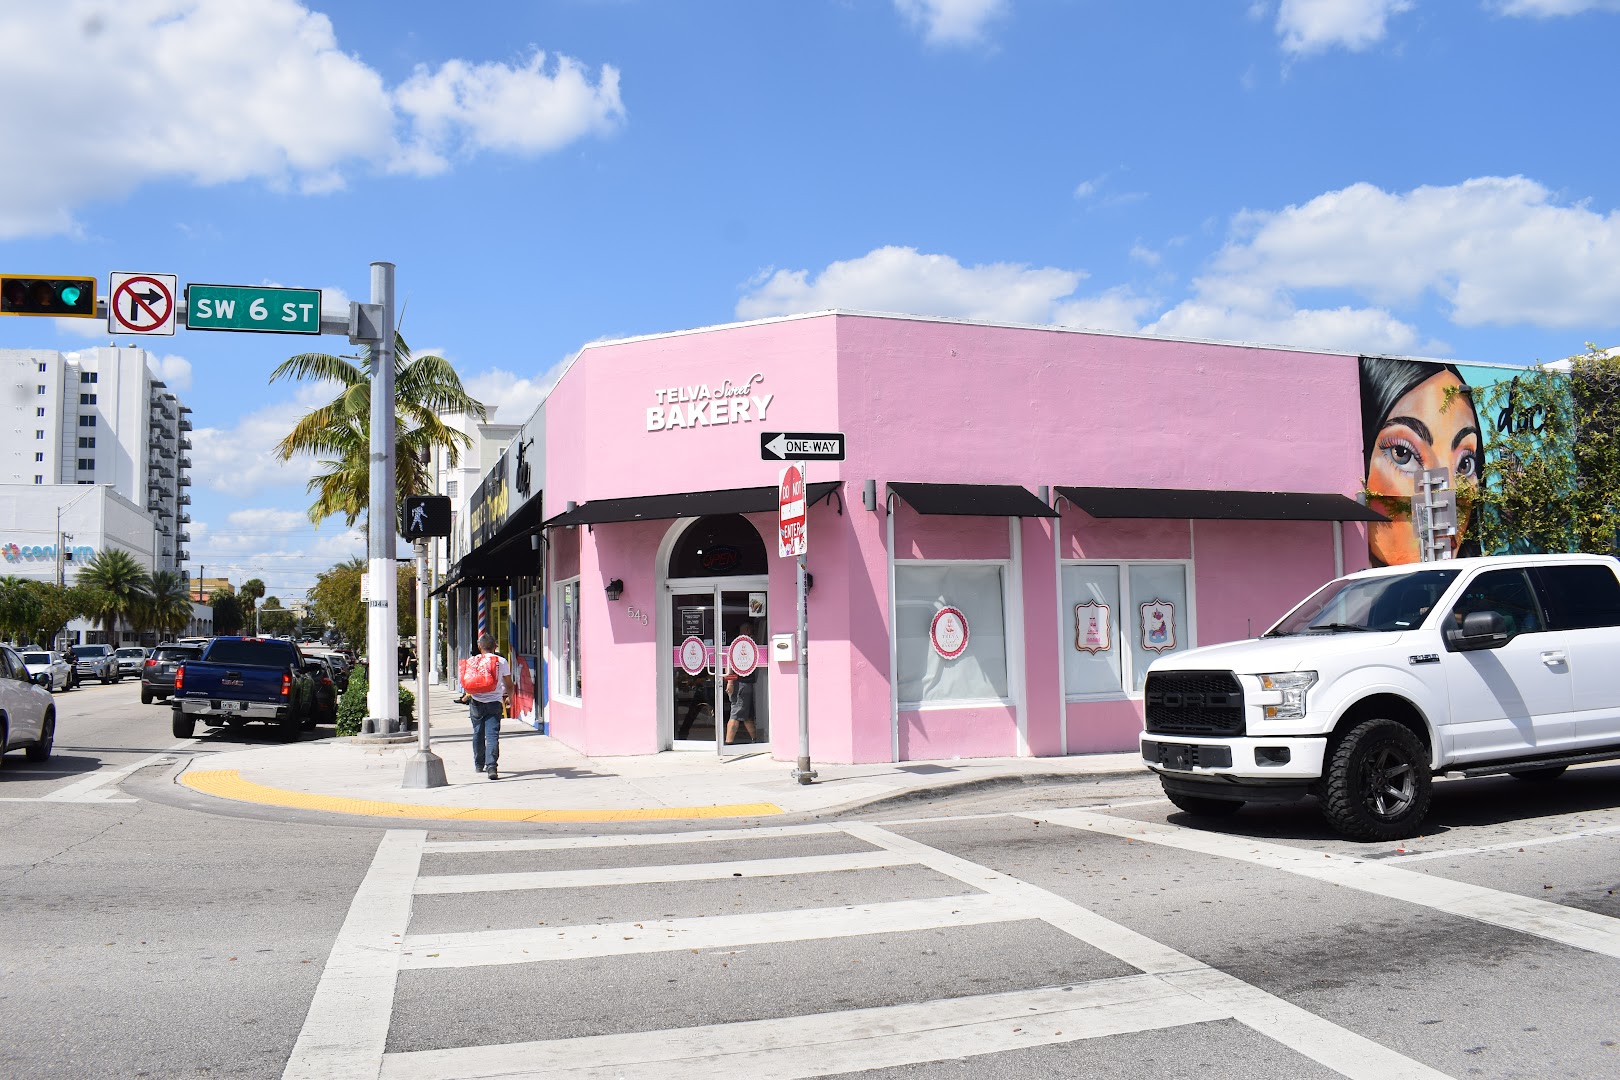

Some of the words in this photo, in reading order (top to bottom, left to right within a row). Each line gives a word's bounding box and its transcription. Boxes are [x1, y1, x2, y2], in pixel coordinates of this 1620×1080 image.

[196, 298, 236, 319] SW
[249, 297, 268, 321] 6
[281, 303, 315, 323] ST
[655, 384, 713, 405] TELVA
[713, 372, 765, 398] Sweet
[646, 394, 774, 432] BAKERY
[786, 441, 809, 453] ONE
[812, 441, 836, 453] WAY
[782, 485, 790, 500] DO
[792, 480, 802, 496] NOT
[784, 521, 801, 539] ENTER
[21, 543, 94, 561] cenum
[703, 550, 737, 567] OPEN
[627, 606, 649, 626] 543
[1147, 692, 1241, 708] FORD
